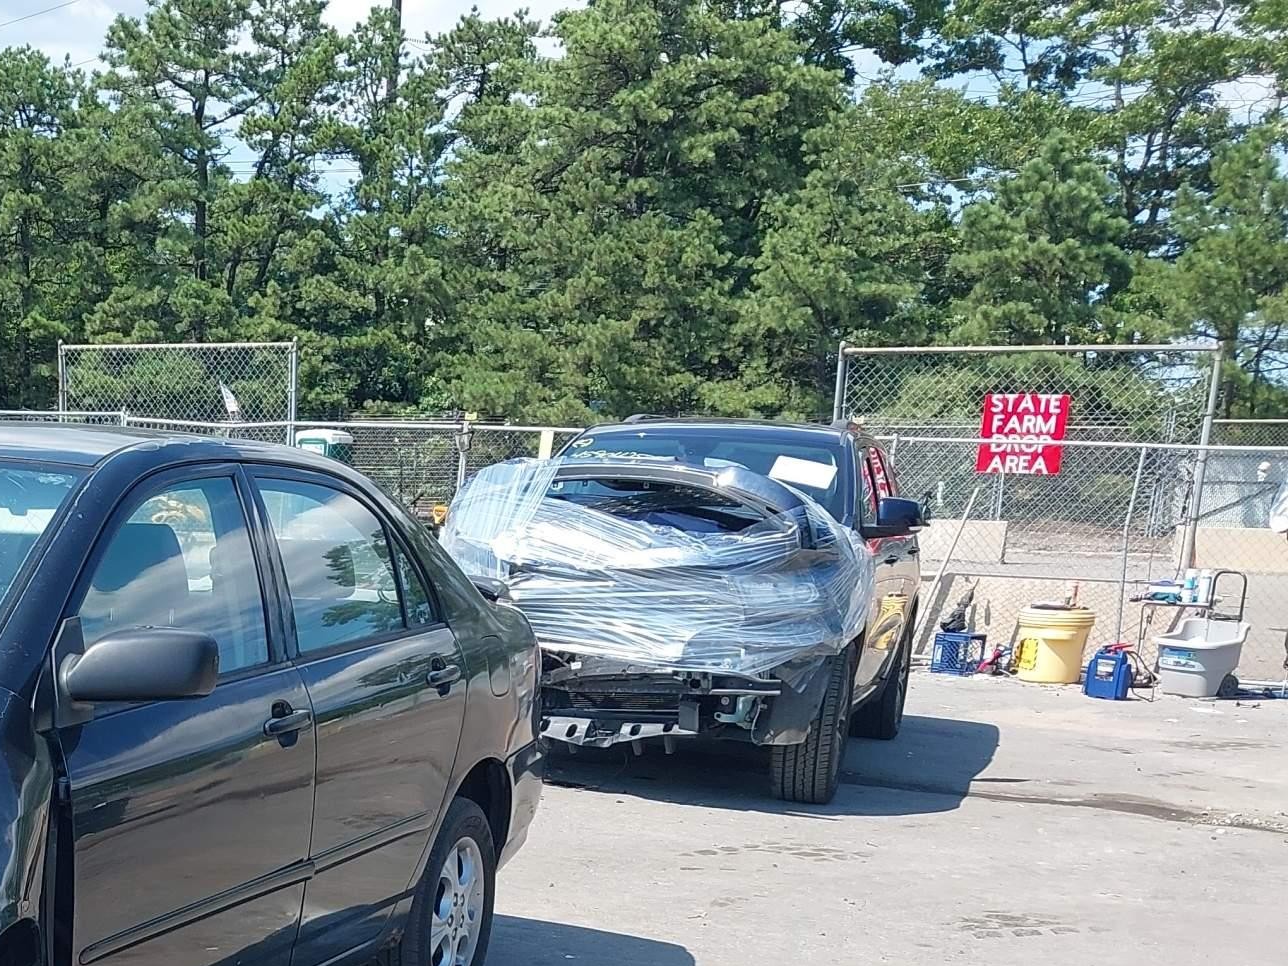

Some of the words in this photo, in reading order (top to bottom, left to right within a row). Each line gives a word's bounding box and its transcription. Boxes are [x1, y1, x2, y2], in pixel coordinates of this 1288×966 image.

[990, 394, 1063, 413] STATE
[991, 415, 1057, 433] FARM
[989, 434, 1053, 454] DROP
[985, 455, 1048, 474] AREA
